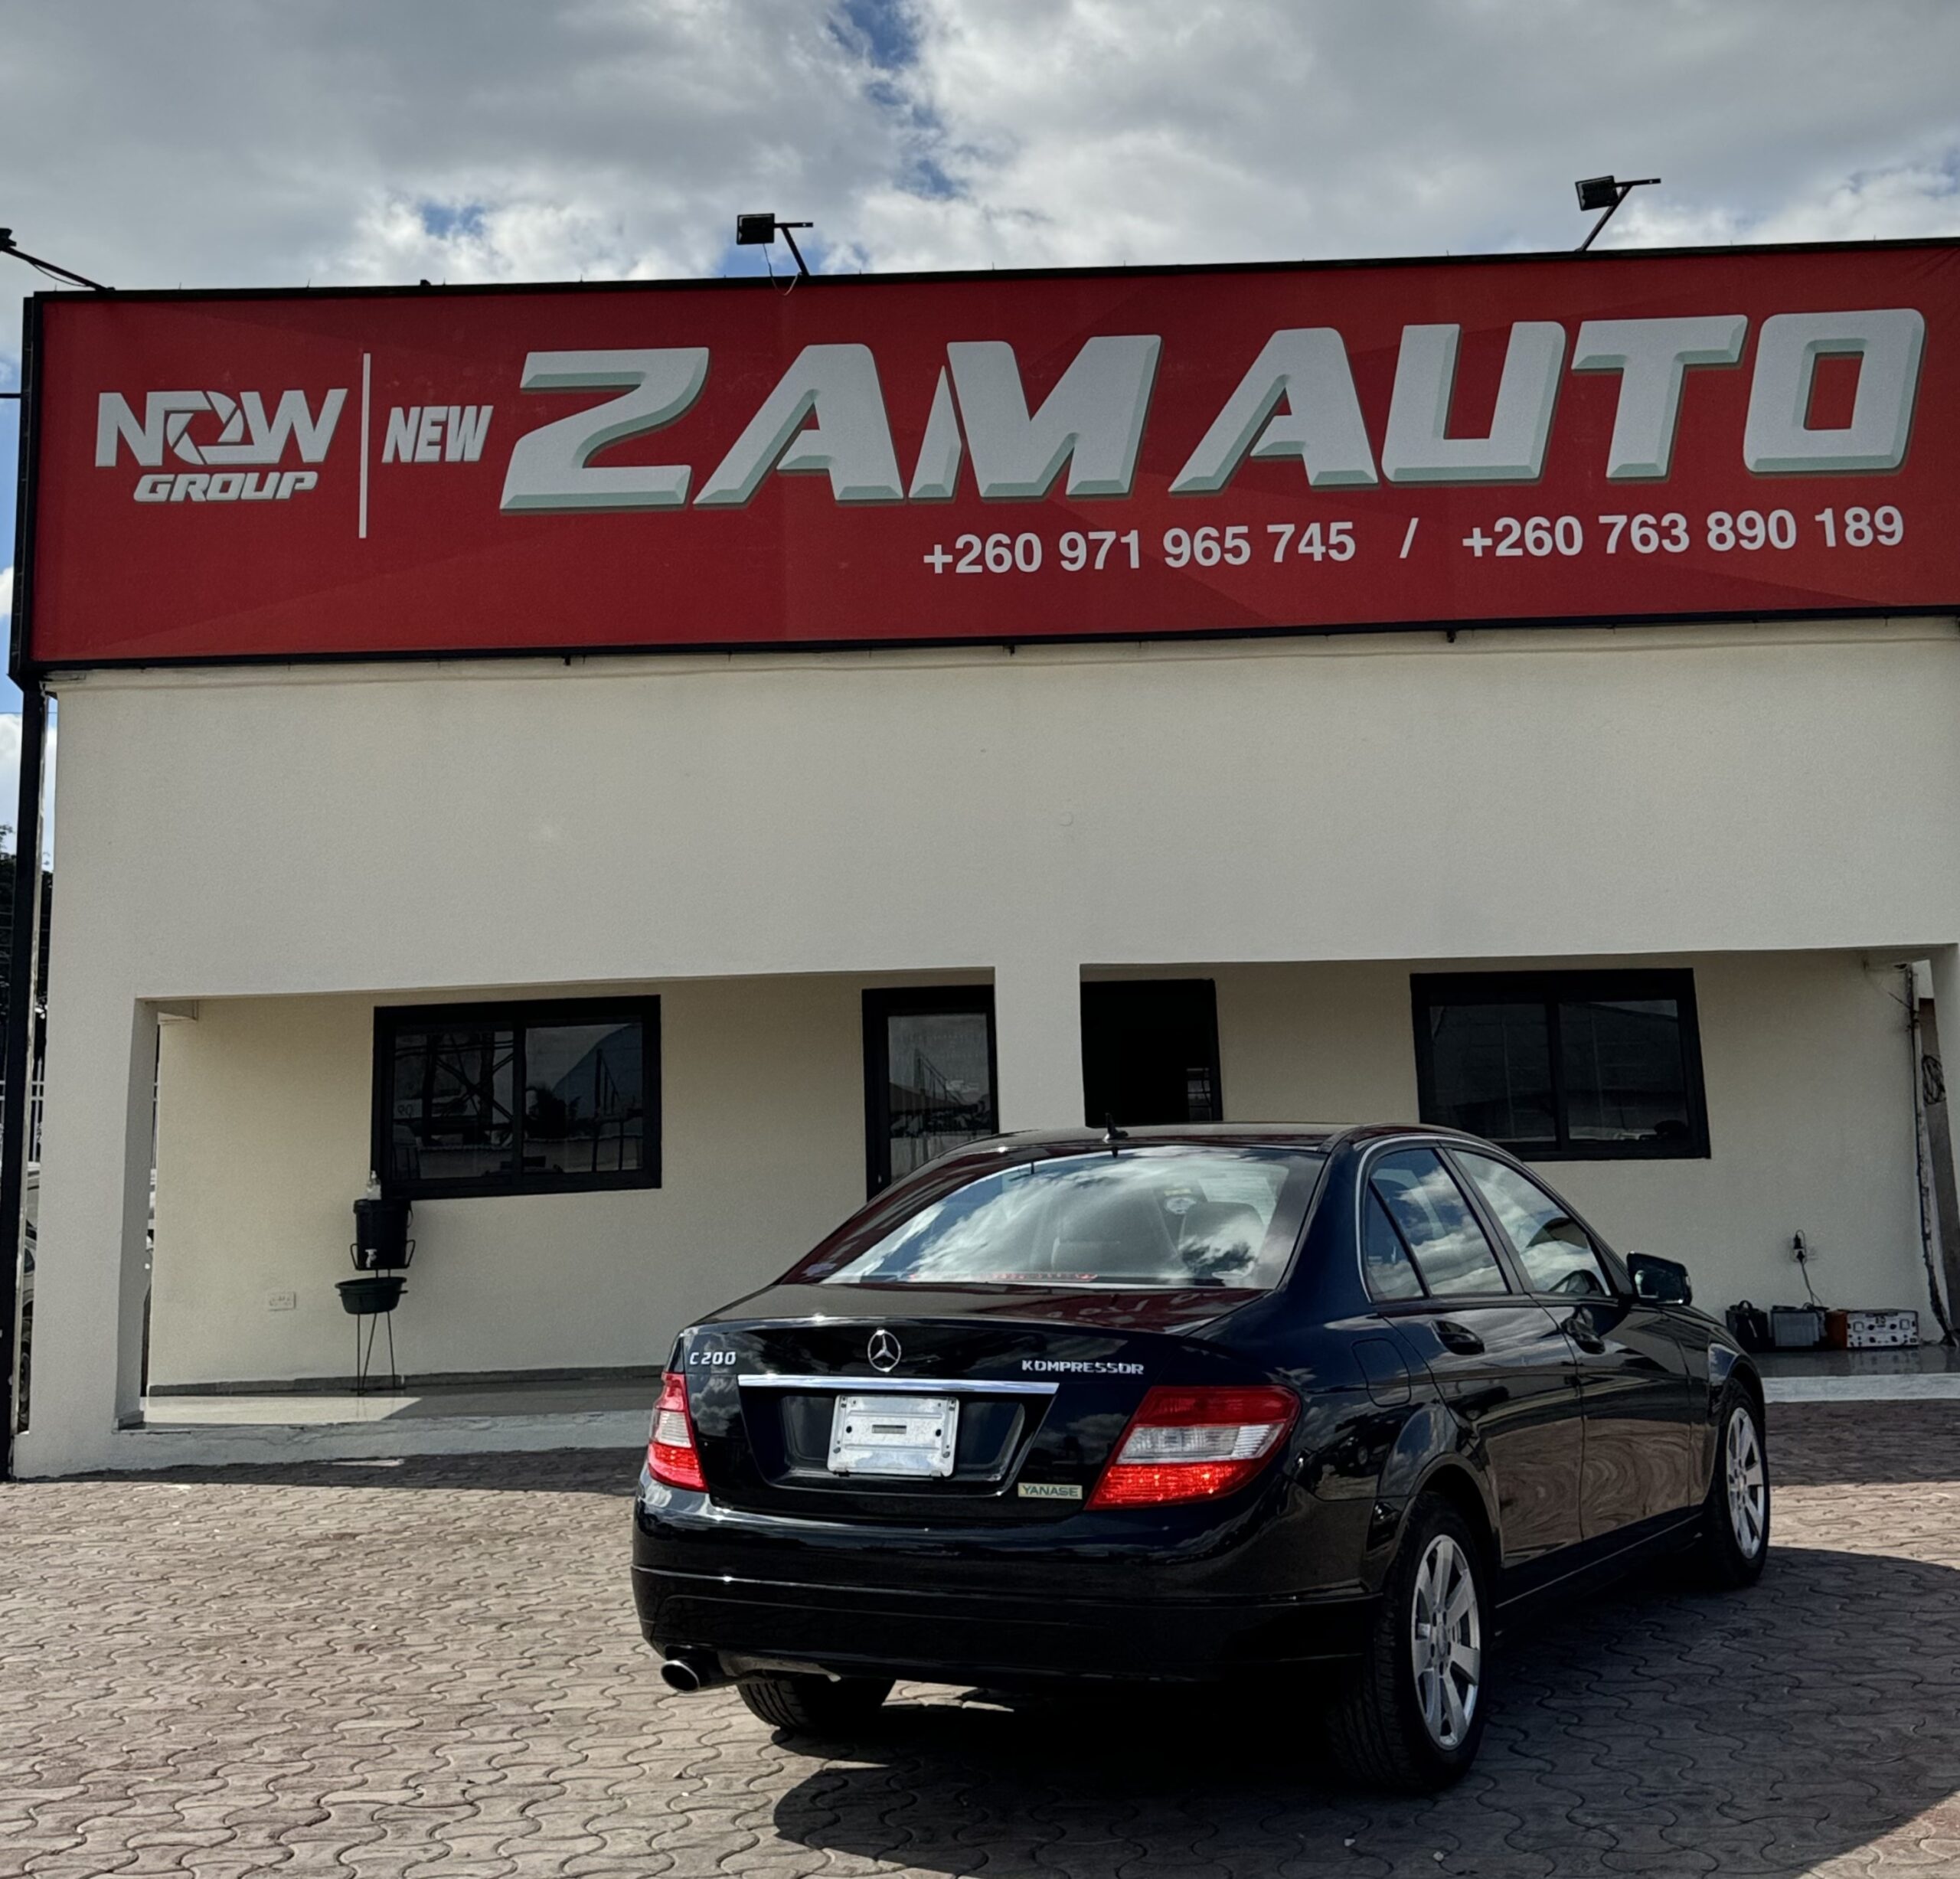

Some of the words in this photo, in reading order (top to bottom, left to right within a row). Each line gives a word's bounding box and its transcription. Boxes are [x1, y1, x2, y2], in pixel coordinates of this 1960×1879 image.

[382, 406, 493, 462] NEW
[500, 335, 1161, 511] ZAM
[1168, 308, 1926, 492] AUTO
[96, 389, 348, 466] NOW
[133, 471, 318, 502] GROUP
[923, 532, 1042, 574] +260
[1059, 529, 1140, 572] 971
[1163, 525, 1251, 568] 965
[1267, 521, 1356, 563] 745
[1399, 517, 1419, 559] /
[1462, 515, 1583, 557] +260
[1598, 512, 1690, 554] 763
[1707, 508, 1797, 551] 890
[1815, 505, 1904, 547] 189
[689, 1351, 700, 1365] C
[701, 1351, 737, 1365] 200
[1021, 1359, 1145, 1375] KOMPRESSOR
[1022, 1485, 1079, 1498] YANASE
